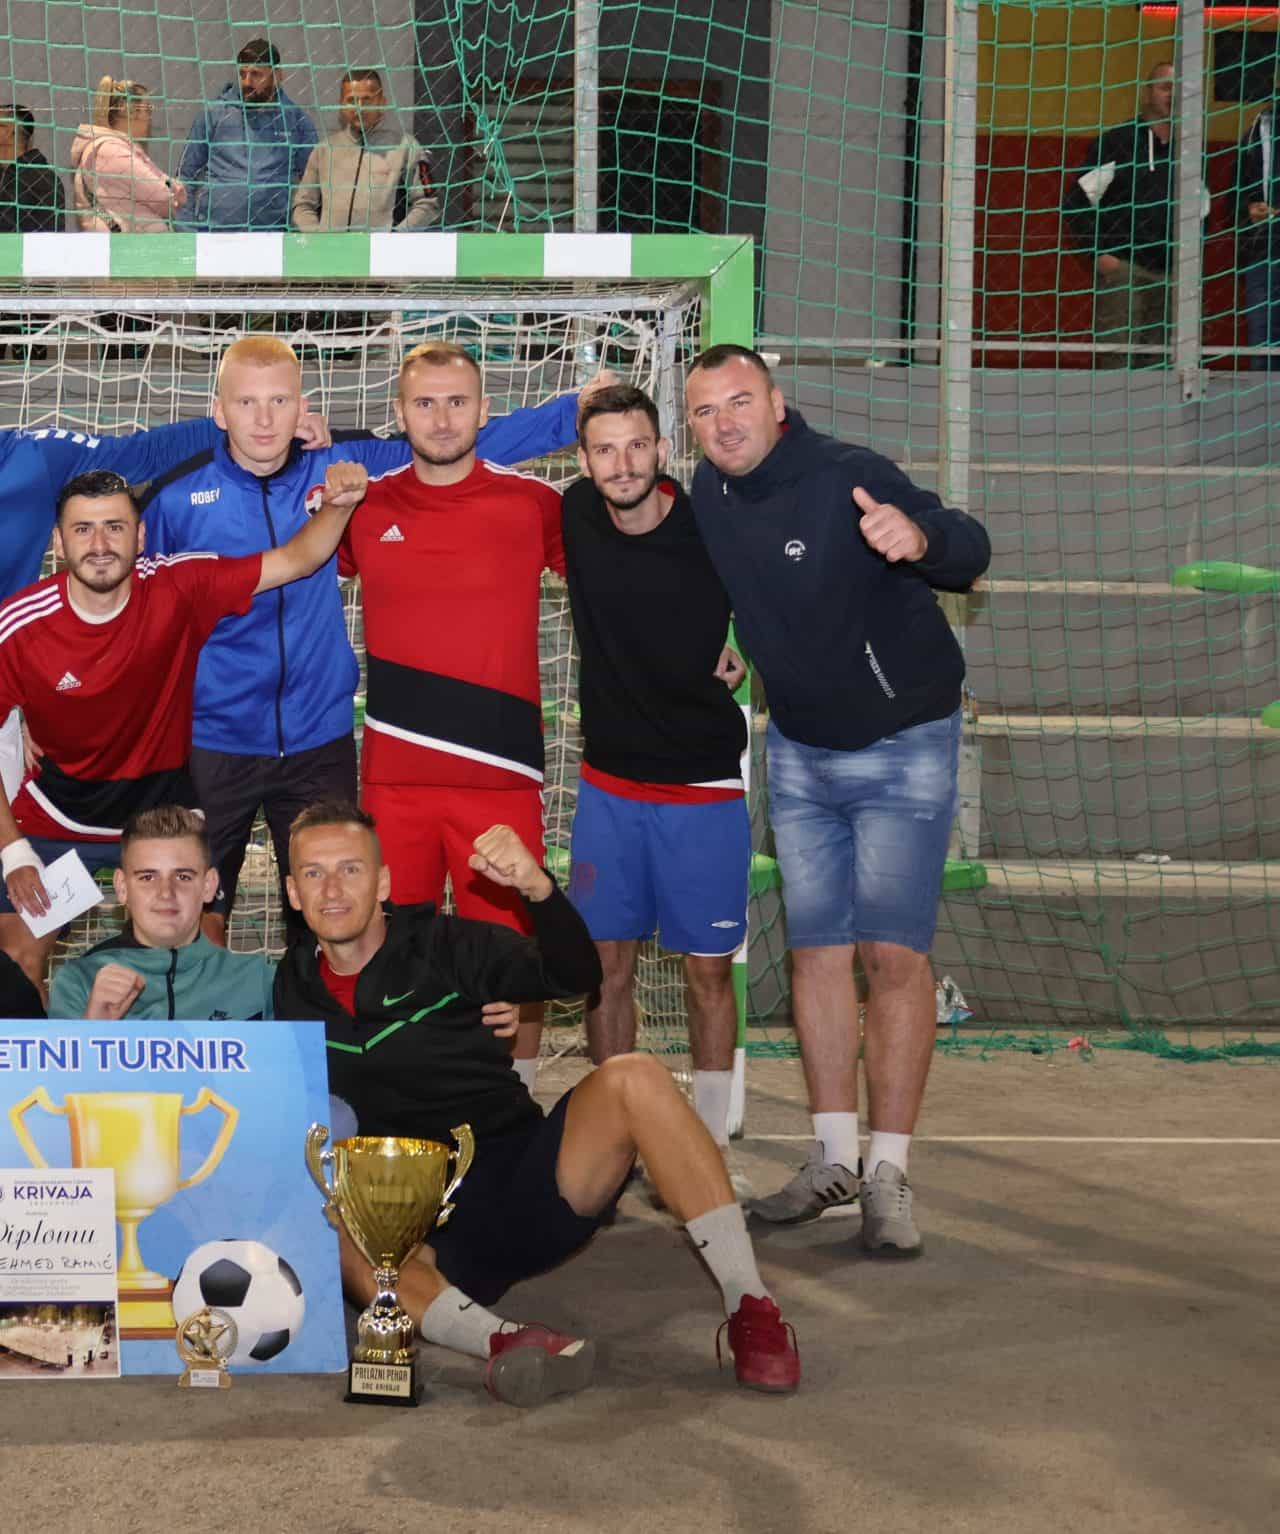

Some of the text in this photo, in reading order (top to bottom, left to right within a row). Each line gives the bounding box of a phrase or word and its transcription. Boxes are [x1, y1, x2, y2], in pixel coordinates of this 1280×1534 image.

[190, 488, 220, 506] ROBEY
[91, 1037, 247, 1071] TURNIR
[14, 1185, 93, 1200] KRIVAJA
